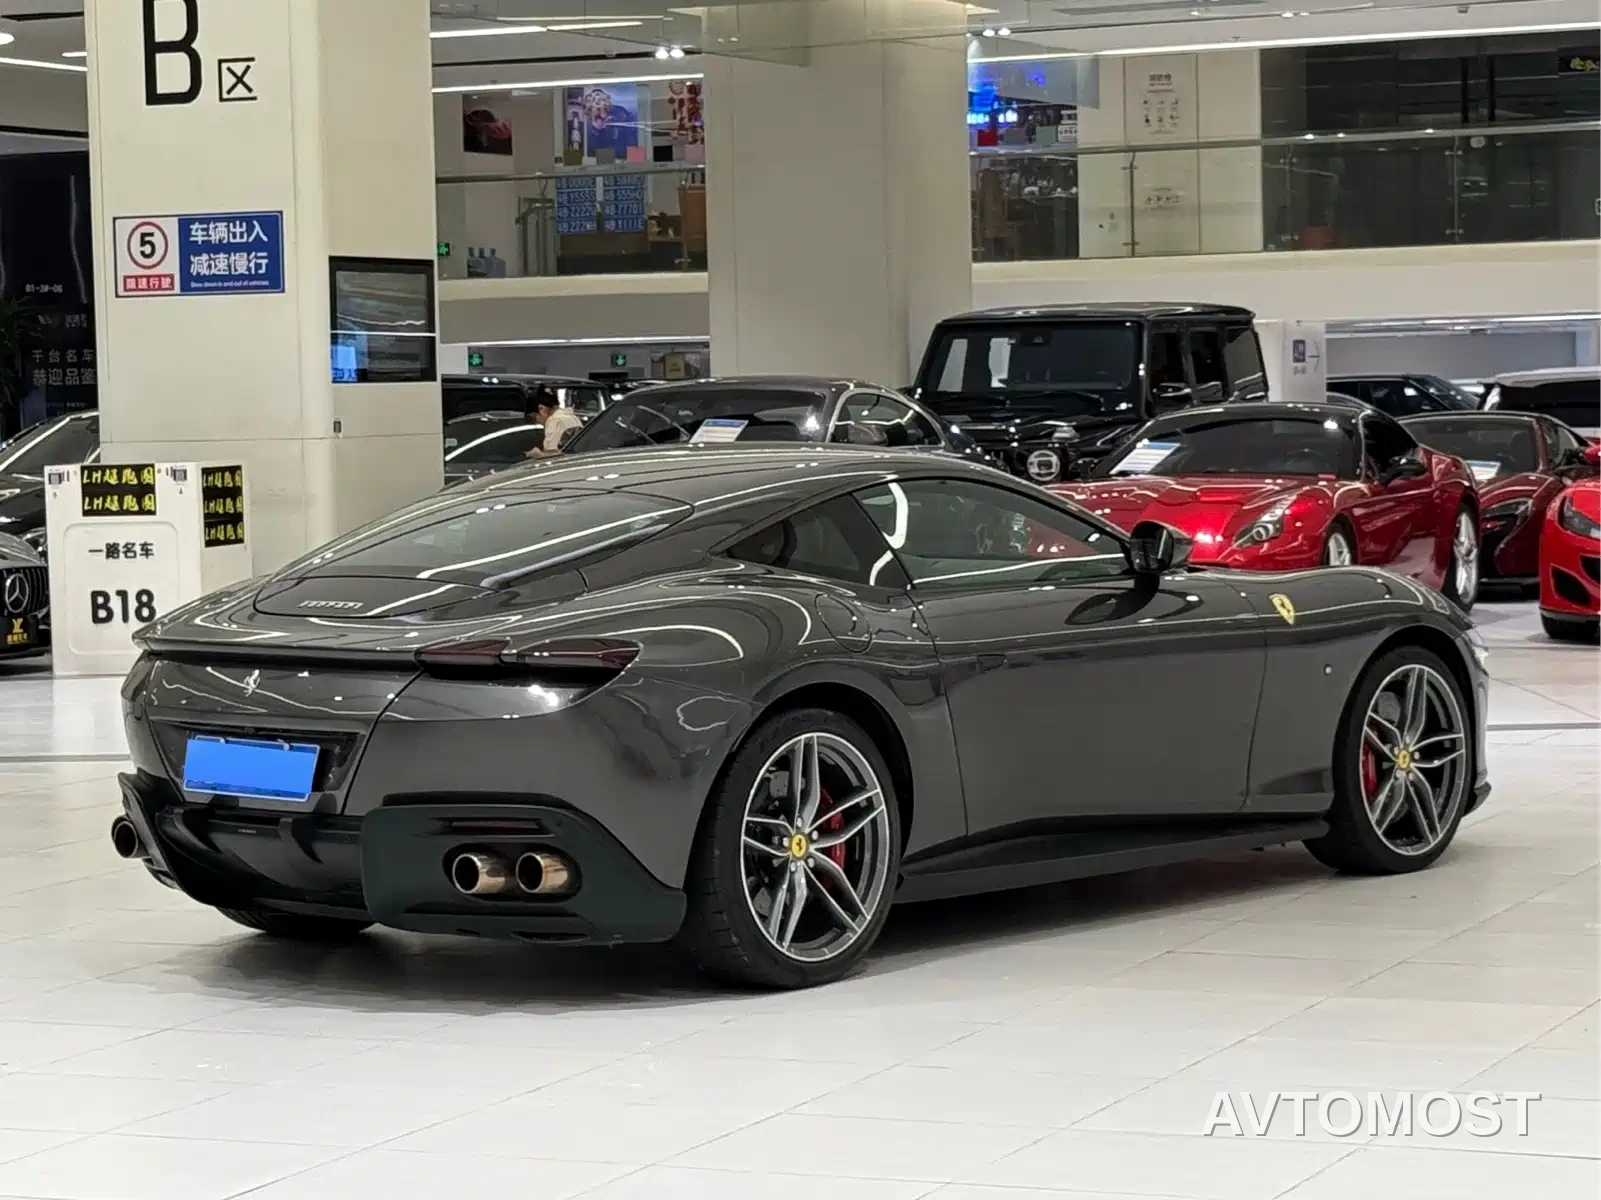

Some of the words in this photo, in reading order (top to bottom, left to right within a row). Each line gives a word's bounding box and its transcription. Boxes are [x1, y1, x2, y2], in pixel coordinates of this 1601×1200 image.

[143, 0, 203, 106] B
[218, 57, 258, 102] 区
[139, 231, 156, 260] 5
[189, 220, 269, 245] 车辆出入
[190, 251, 269, 276] 减速慢行
[88, 541, 155, 559] 一路名车
[91, 589, 156, 624] B18
